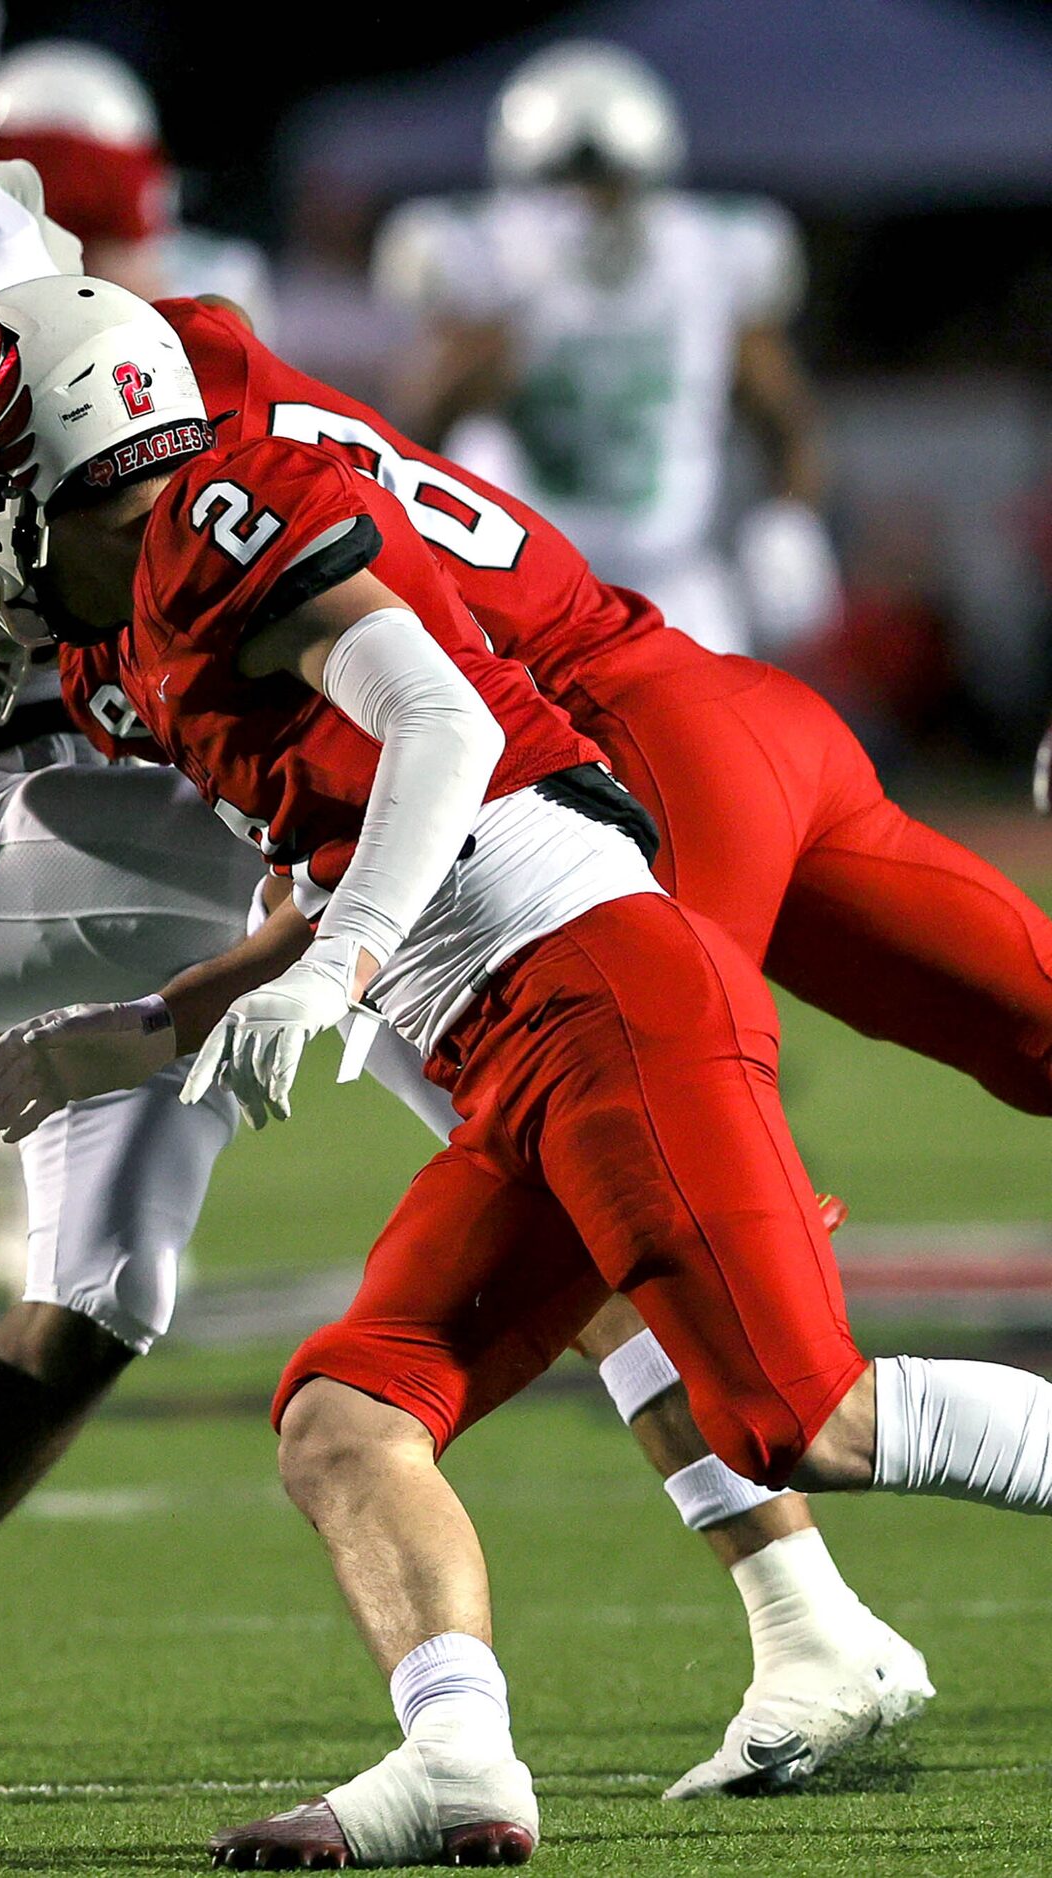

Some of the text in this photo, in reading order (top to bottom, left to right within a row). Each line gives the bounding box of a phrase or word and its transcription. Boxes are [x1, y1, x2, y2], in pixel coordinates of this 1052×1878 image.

[112, 361, 155, 420] 2
[114, 424, 202, 476] EAGLES
[191, 479, 288, 567] 2
